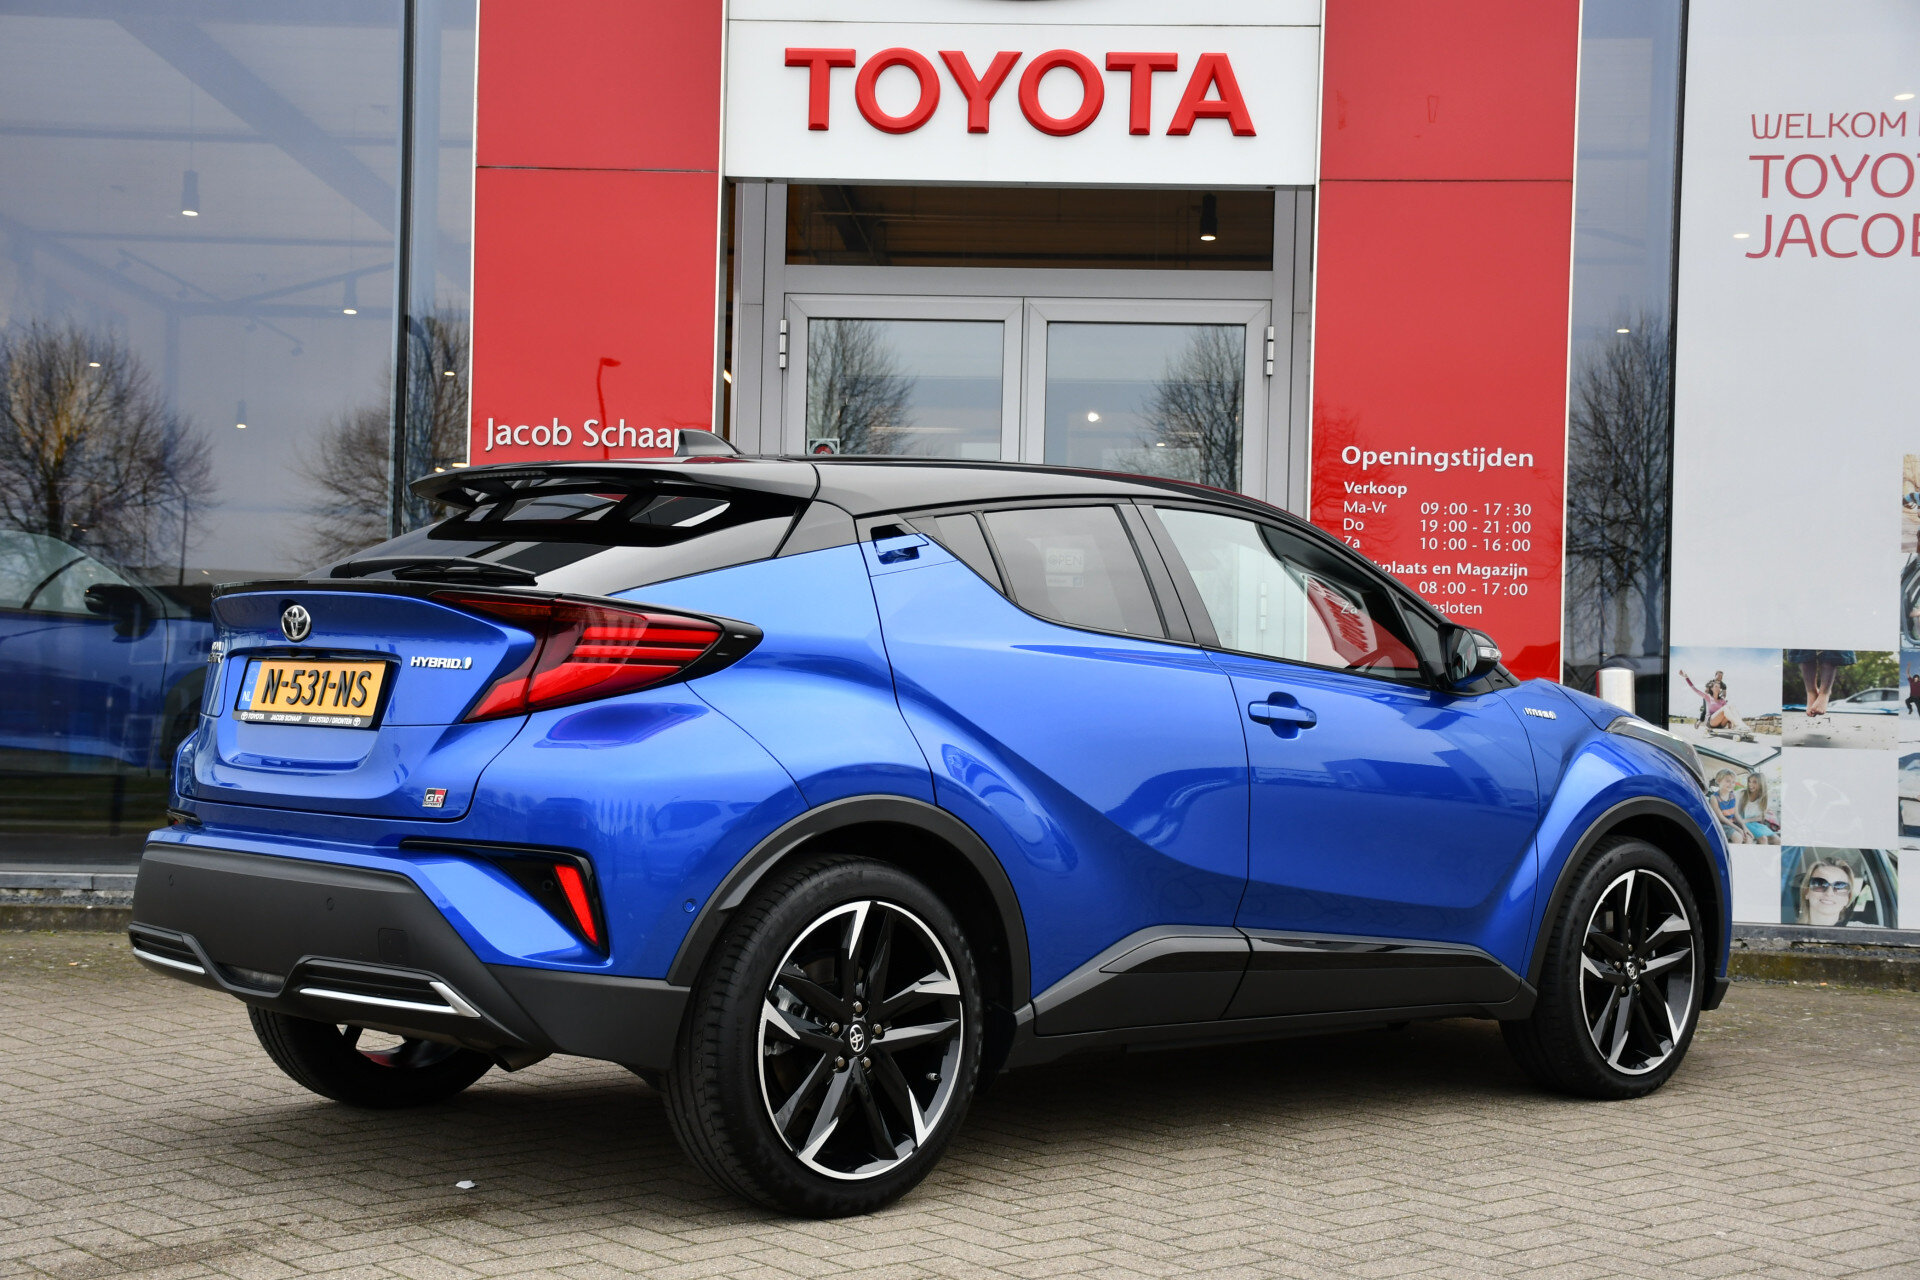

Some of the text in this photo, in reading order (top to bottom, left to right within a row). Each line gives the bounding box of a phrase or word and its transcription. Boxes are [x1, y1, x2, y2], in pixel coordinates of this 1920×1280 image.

[784, 47, 1257, 137] TOYOTA
[1751, 111, 1907, 140] WELKOM
[1749, 152, 1920, 199] TOYO
[485, 417, 572, 451] Jacob
[1341, 445, 1534, 472] Openingstijden
[1344, 481, 1408, 498] Verkoop
[1343, 501, 1387, 514] Ma-Vr
[1343, 518, 1364, 531] Do
[1343, 535, 1361, 549] Za
[1432, 565, 1451, 575] en
[1456, 562, 1528, 579] Magazijn
[1340, 601, 1358, 614] Za
[410, 656, 463, 669] HYBRID
[242, 690, 251, 702] NL
[261, 668, 372, 708] N-531-NS
[425, 794, 445, 802] GR
